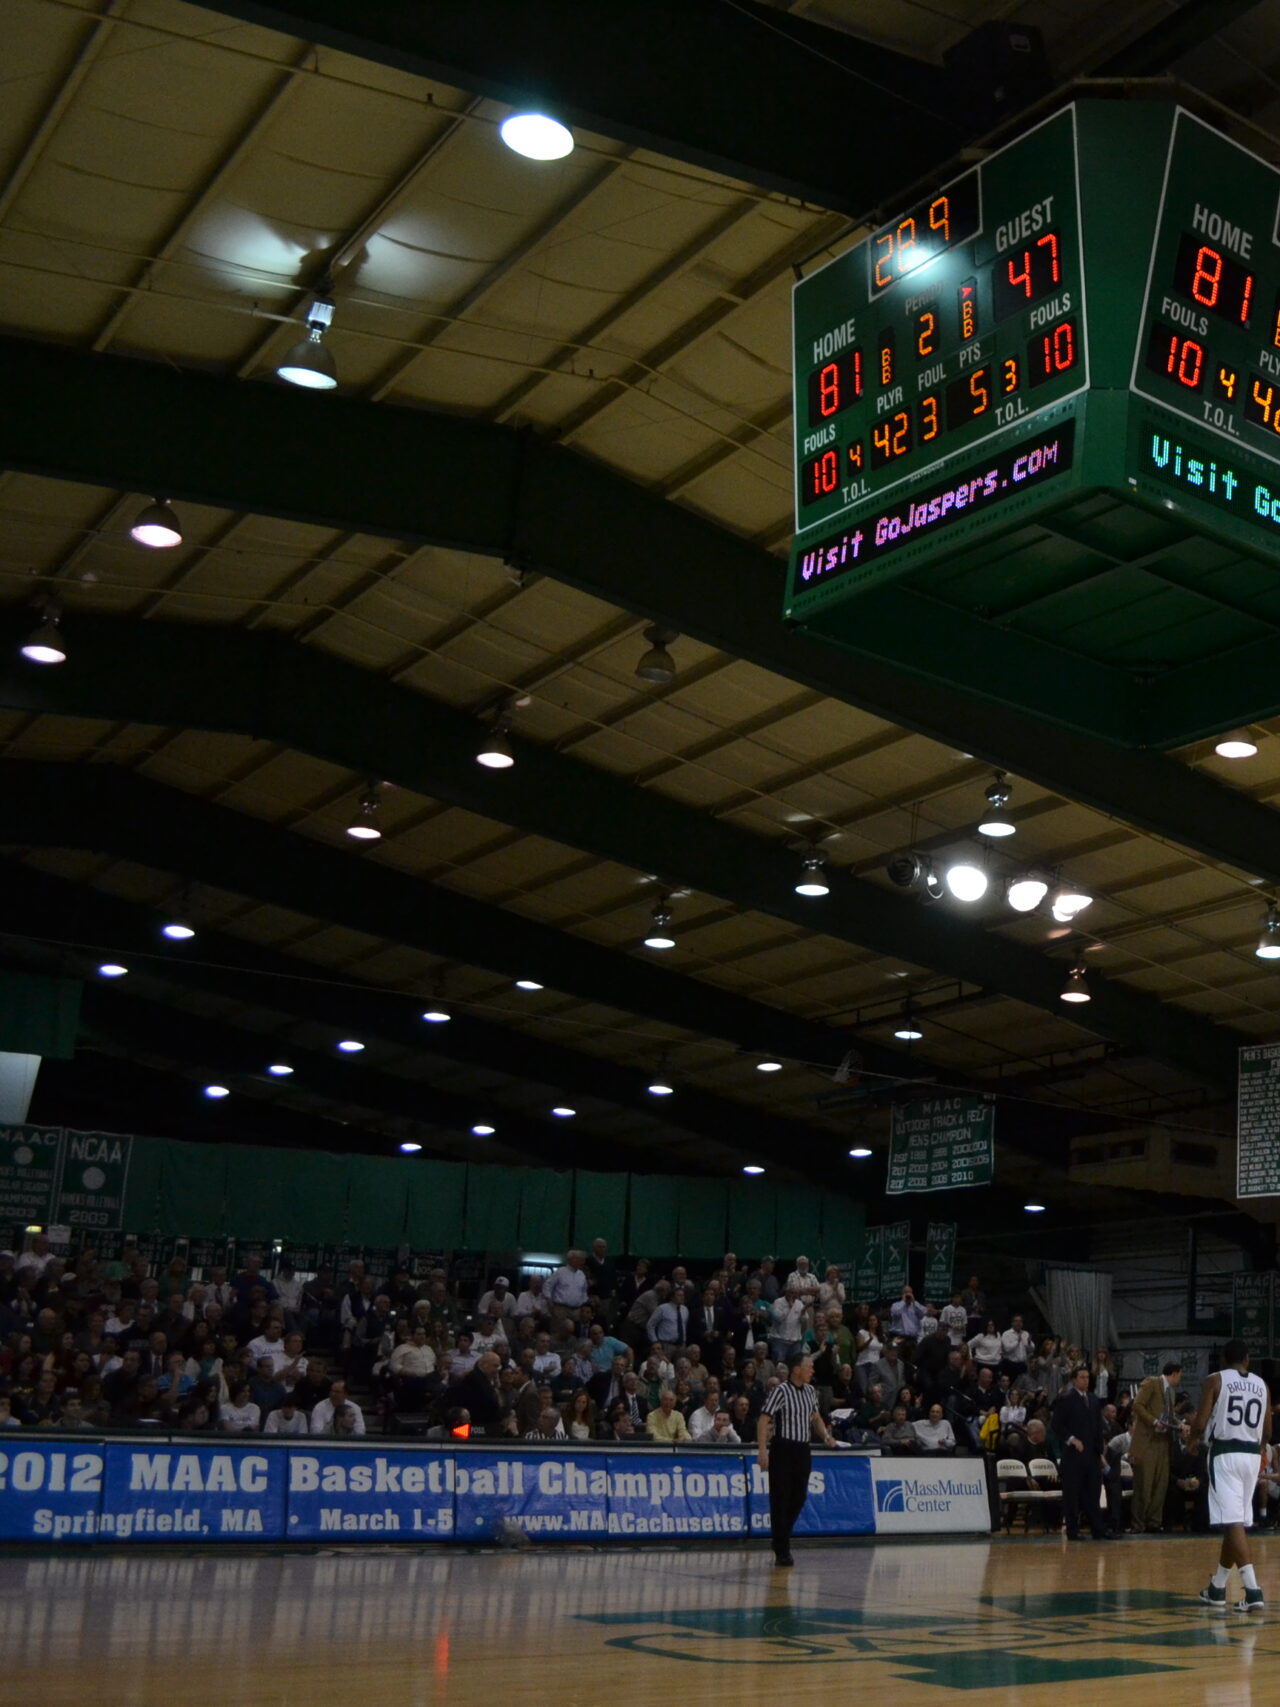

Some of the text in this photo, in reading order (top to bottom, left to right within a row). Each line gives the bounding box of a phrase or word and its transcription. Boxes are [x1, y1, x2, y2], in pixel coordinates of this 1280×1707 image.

[995, 195, 1054, 252] GUEST
[1192, 203, 1254, 261] HOME
[875, 196, 950, 287] 289
[1007, 232, 1060, 298] 47
[1191, 245, 1255, 324] 81
[1029, 292, 1071, 330] FOULS
[1161, 296, 1210, 337] FOULS
[813, 318, 856, 364] HOME
[917, 312, 935, 356] 2
[1043, 322, 1074, 375] 10
[959, 342, 981, 369] PTS
[1167, 335, 1204, 388] 10
[819, 350, 862, 418] 81
[917, 363, 946, 391] FOUL
[969, 368, 988, 416] 5
[1004, 359, 1018, 393] 3
[1218, 367, 1237, 400] 4
[876, 386, 904, 415] PLYR
[922, 395, 938, 441] 3
[994, 396, 1029, 427] T.O.L.
[873, 411, 910, 458] 42
[1202, 401, 1240, 436] T.O.L.
[803, 424, 837, 456] FOULS
[849, 443, 862, 468] 4
[812, 449, 838, 496] 10
[1151, 433, 1239, 502] Visit
[841, 477, 871, 505] T.O.L.
[801, 529, 864, 582] Visit
[922, 1097, 962, 1116] MAAC
[70, 1137, 123, 1165] NCAA
[951, 1171, 974, 1183] 2010
[68, 1209, 110, 1225] 2003
[1235, 1273, 1270, 1288] MAAC
[1226, 1381, 1264, 1398] BRUTUS
[1226, 1395, 1263, 1429] 50
[0, 1451, 826, 1505] 012 MAAC Basketball Championshs
[904, 1478, 983, 1497] MassMutual
[33, 1507, 773, 1539] Springfield, MA March 1-5 www.MAACachusetts.co
[904, 1498, 952, 1513] Center
